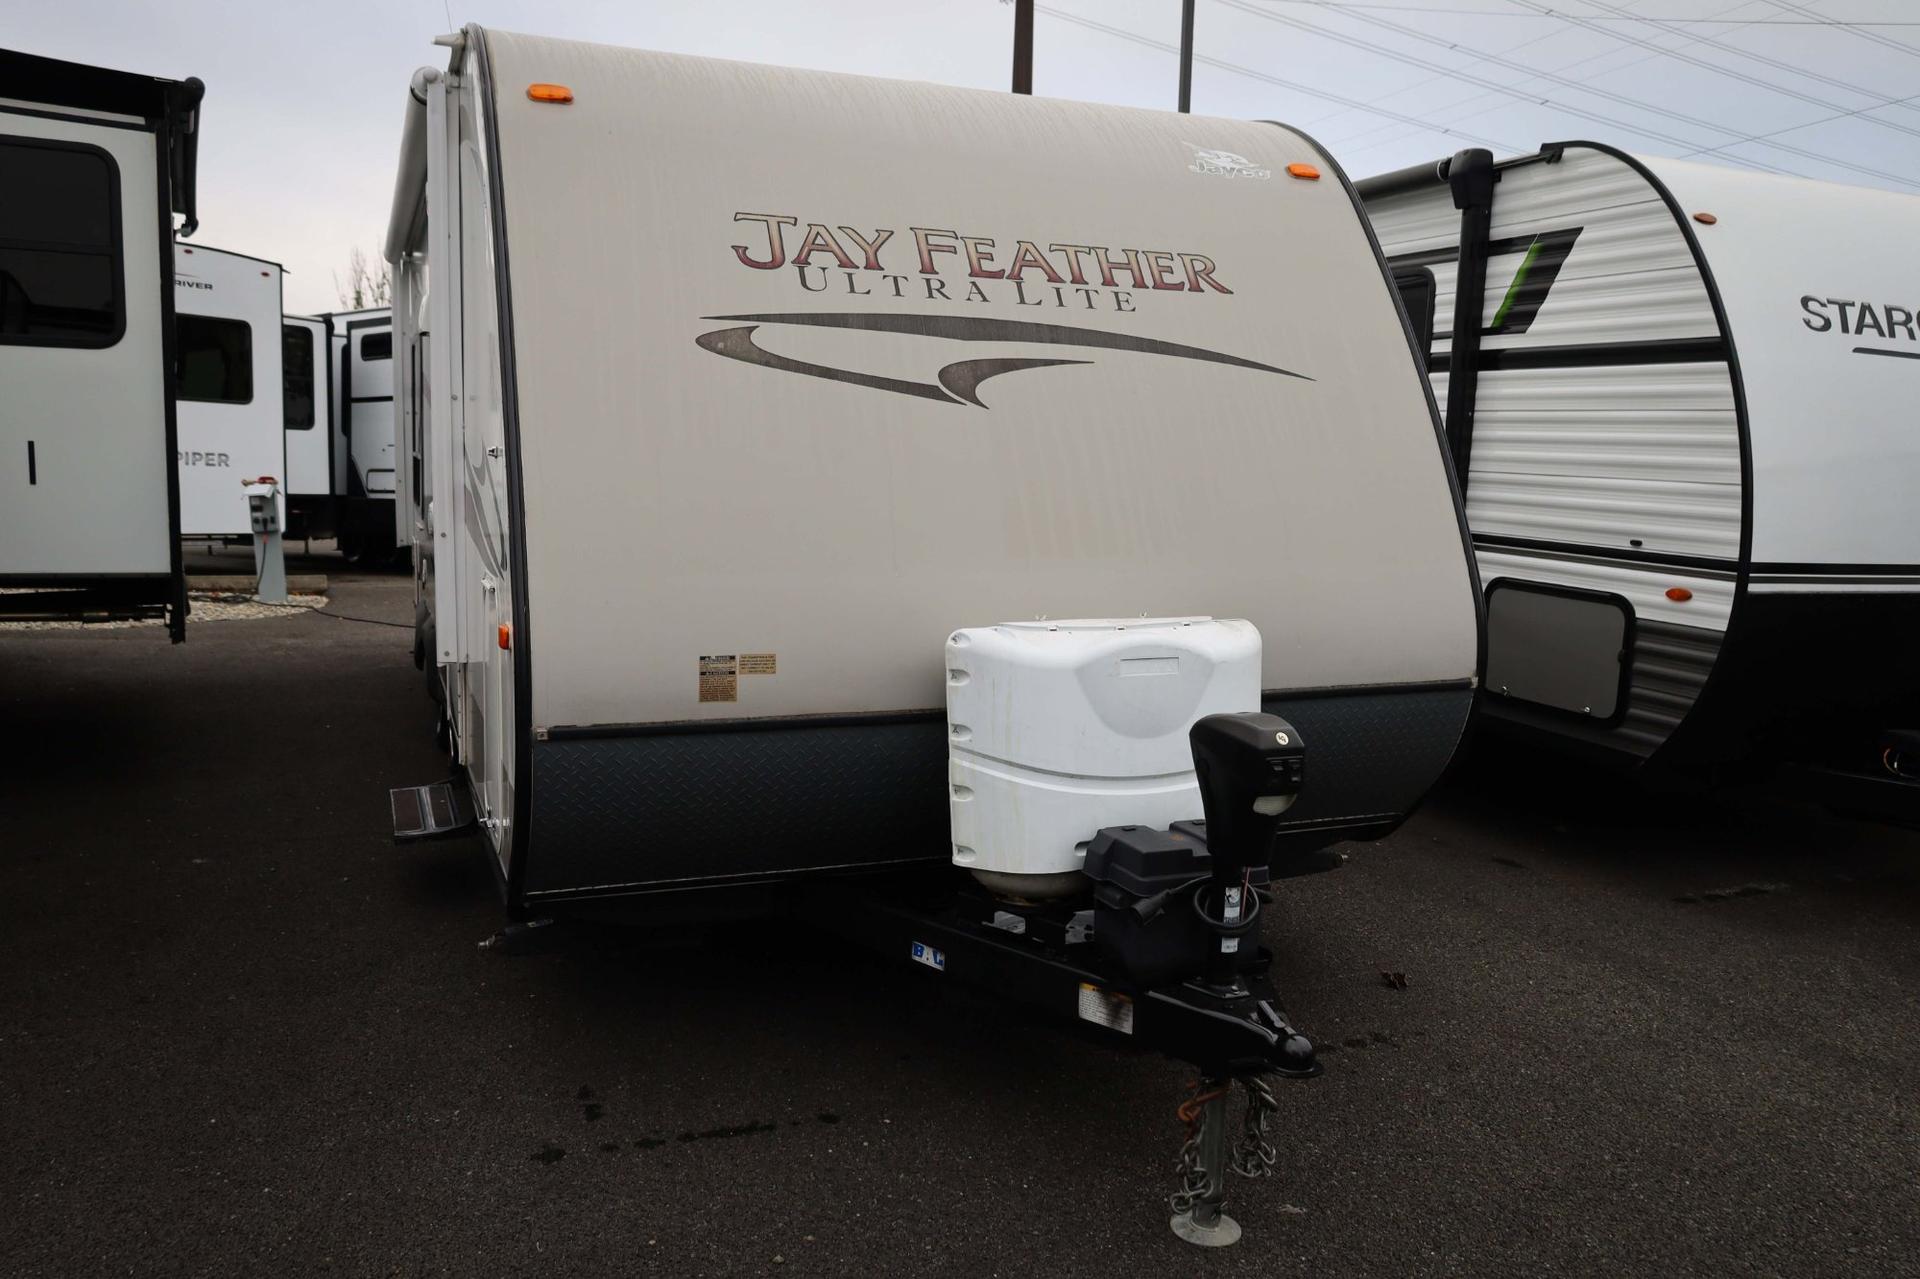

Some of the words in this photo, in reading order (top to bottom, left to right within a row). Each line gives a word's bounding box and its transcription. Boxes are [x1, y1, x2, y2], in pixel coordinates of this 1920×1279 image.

[731, 212, 895, 270] JAY
[909, 227, 1234, 295] FEATHER
[793, 265, 991, 303] ULTRA
[1014, 281, 1137, 312] LITE
[1800, 295, 1920, 341] STAR
[913, 943, 944, 966] BL
